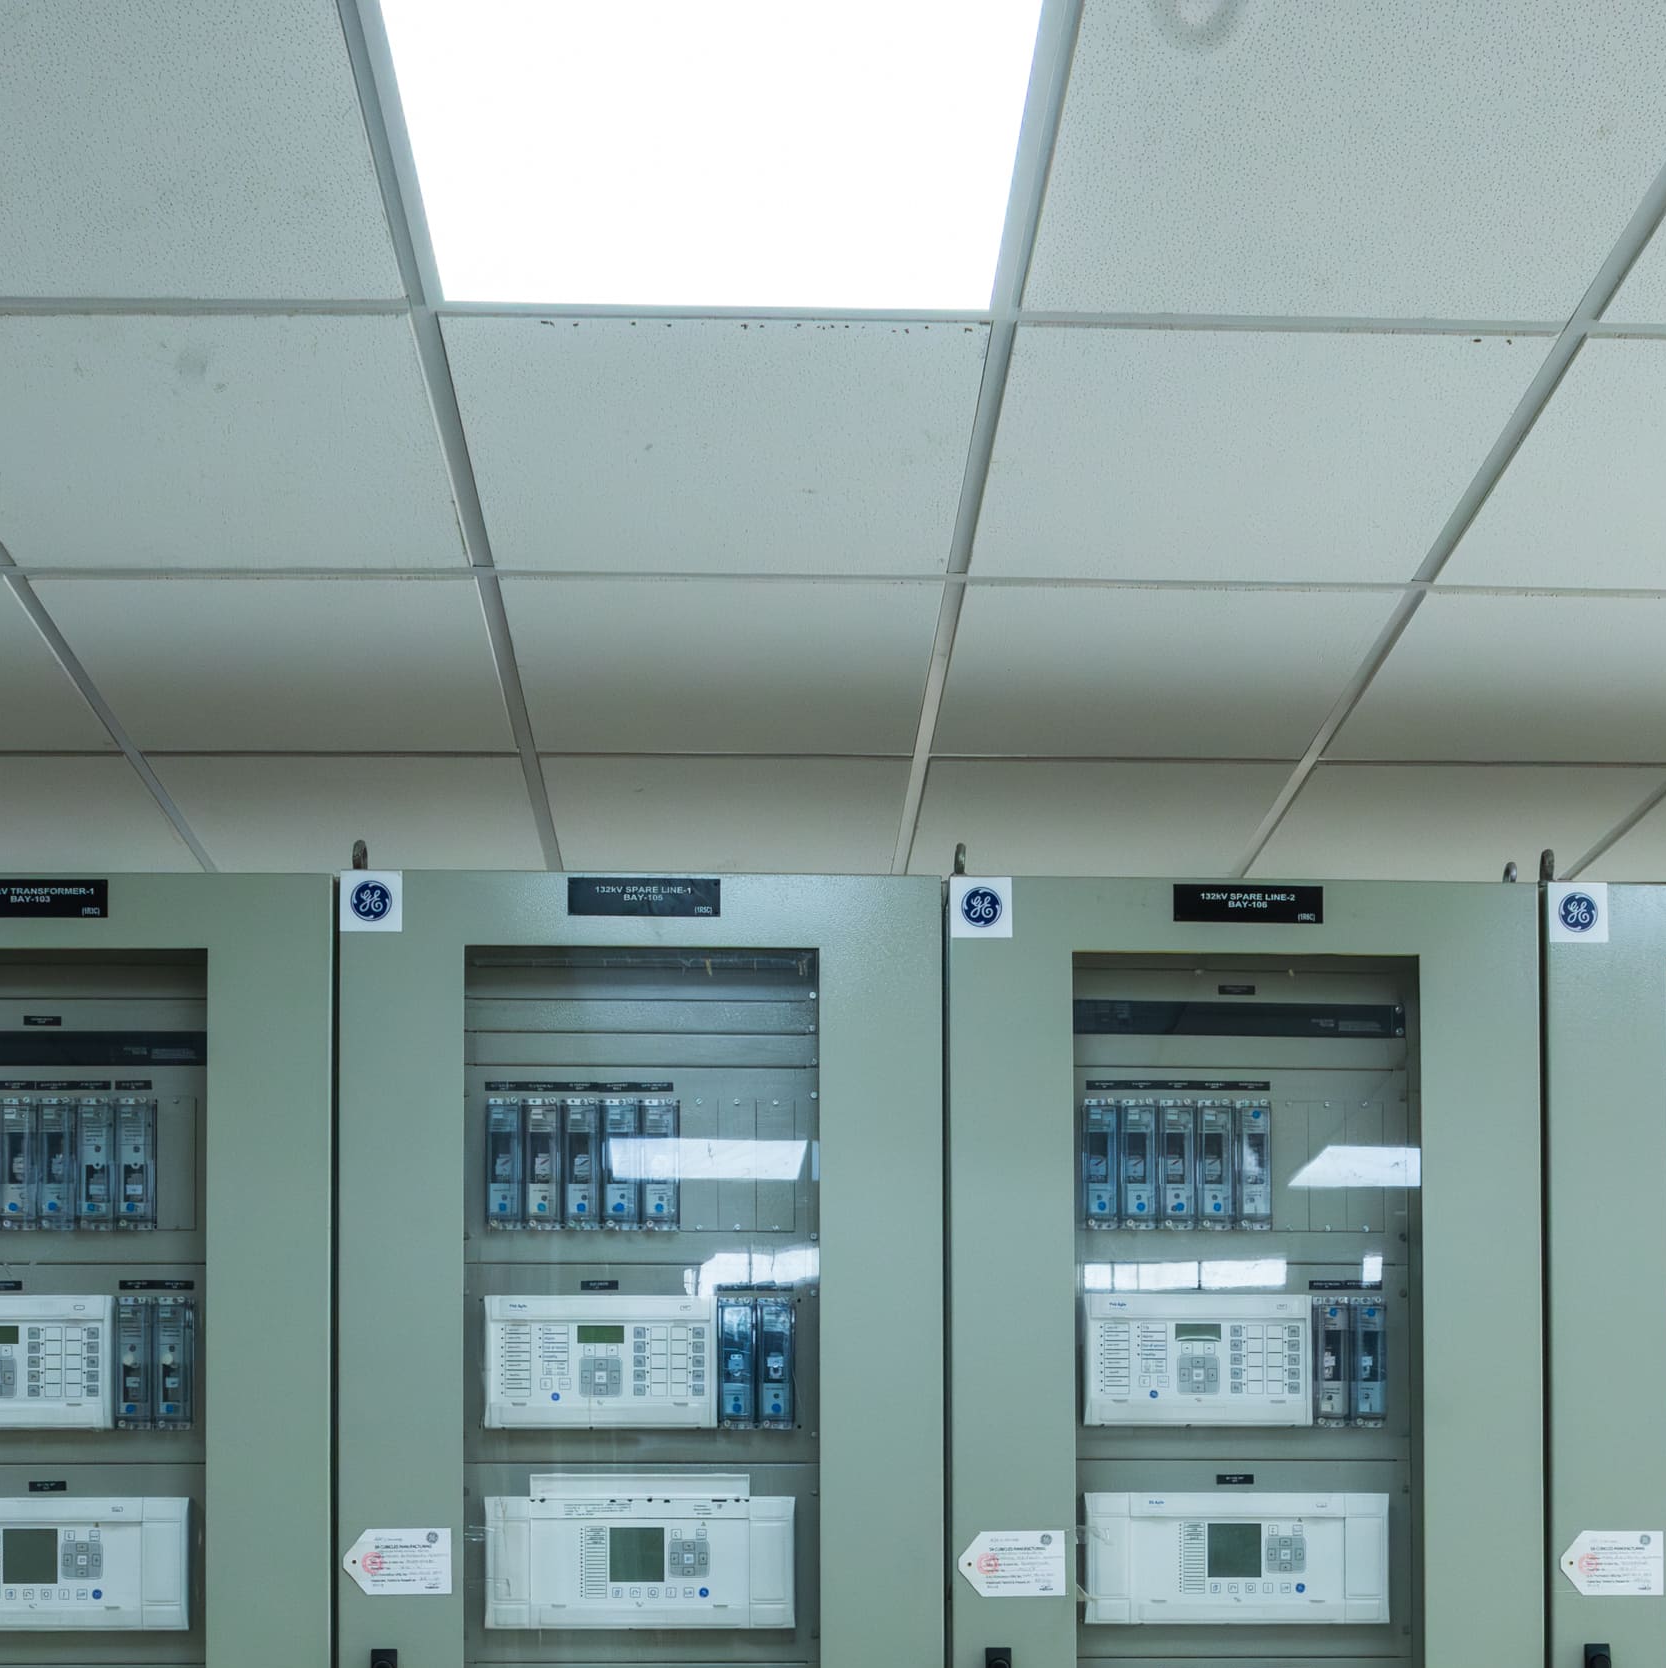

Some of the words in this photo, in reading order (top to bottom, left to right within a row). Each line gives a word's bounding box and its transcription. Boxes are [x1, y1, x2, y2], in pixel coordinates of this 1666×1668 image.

[595, 886, 623, 894] 132kV
[625, 886, 658, 894] SPARE
[1230, 893, 1262, 901] SPARE
[1265, 893, 1295, 901] LINE-2
